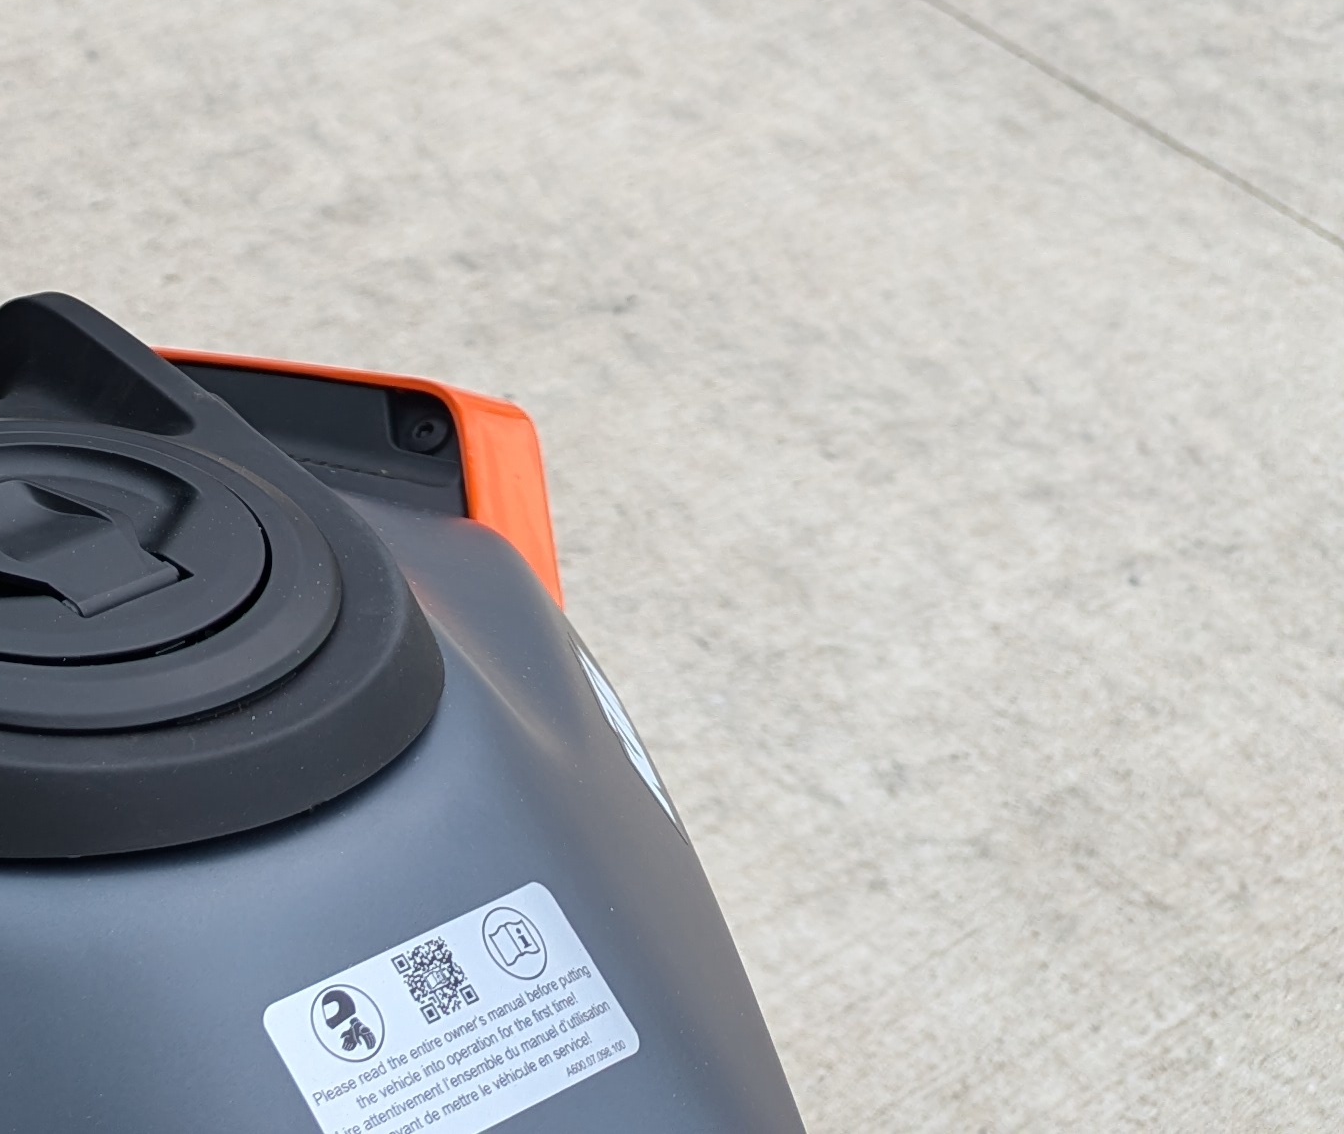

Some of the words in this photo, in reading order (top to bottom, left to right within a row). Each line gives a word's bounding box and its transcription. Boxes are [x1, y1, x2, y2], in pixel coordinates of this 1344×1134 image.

[312, 1078, 357, 1107] Please
[359, 1061, 387, 1084] read
[387, 1052, 408, 1070] the
[409, 1034, 443, 1059] entire
[444, 1014, 487, 1043] owner's
[487, 993, 526, 1021] manual
[525, 980, 559, 1003] before
[558, 965, 592, 990] putting
[356, 1091, 378, 1109] the
[380, 1069, 422, 1094] vehicle
[421, 1058, 445, 1078] into
[446, 1032, 499, 1066] operation
[497, 1025, 514, 1040] for
[514, 1015, 533, 1032] the
[531, 1005, 552, 1023] first
[552, 991, 579, 1014] time!
[363, 1081, 445, 1131] attentivement
[442, 1051, 504, 1091] l'ensemble
[504, 1046, 520, 1060] du
[520, 1023, 559, 1052] manuel
[558, 999, 611, 1034] d'utilisation
[424, 1108, 441, 1125] de
[441, 1090, 480, 1114] mettre
[478, 1083, 492, 1097] le
[492, 1061, 538, 1090] véhicule
[538, 1053, 553, 1068] en
[553, 1031, 593, 1060] service!
